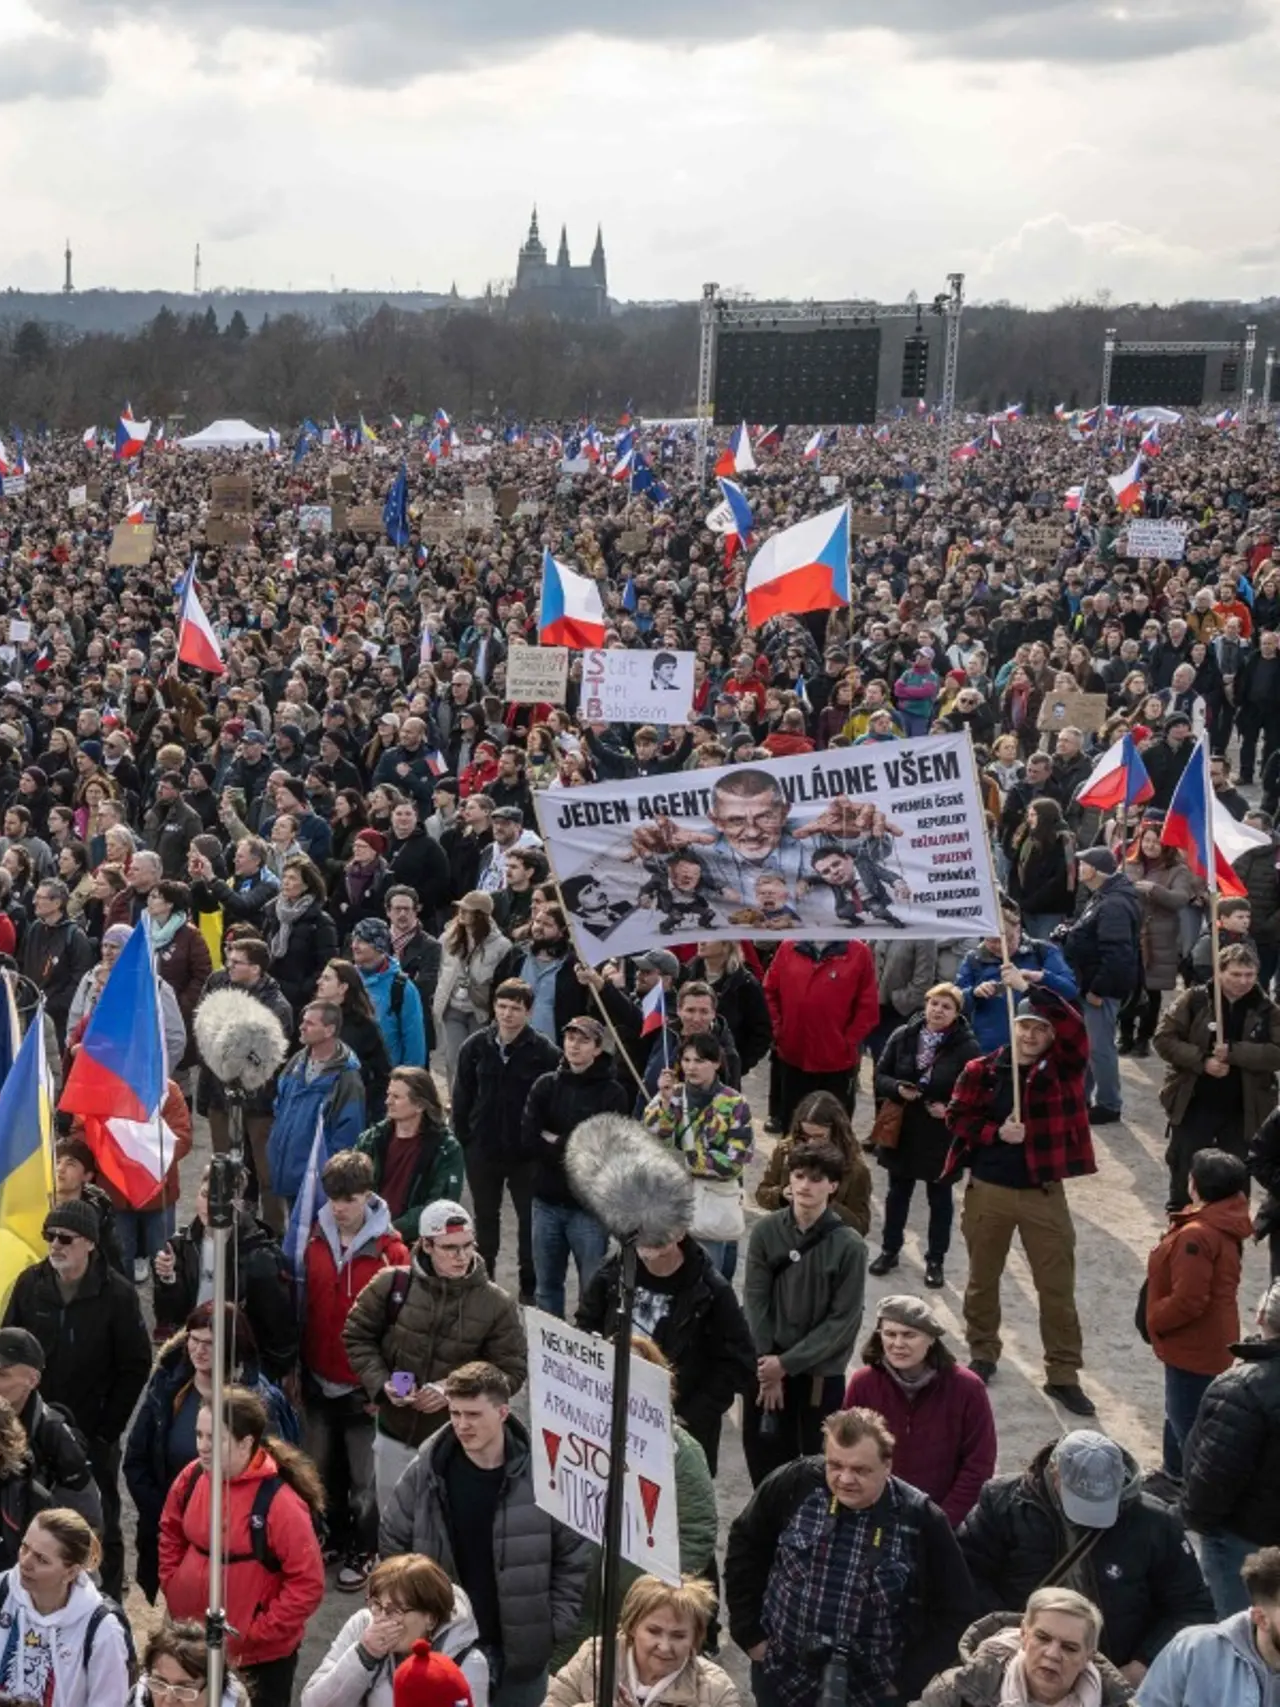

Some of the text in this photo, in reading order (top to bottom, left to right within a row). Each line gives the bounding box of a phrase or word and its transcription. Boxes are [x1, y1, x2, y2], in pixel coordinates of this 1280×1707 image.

[557, 751, 960, 829] JEDEN AGENT VLÁDNE VŠEM
[891, 799, 933, 814] PREMIÉR
[917, 812, 967, 829] REPUBLIKY
[913, 887, 980, 904] POSLANECKOU
[540, 1327, 606, 1371] NECHCEME
[563, 1431, 629, 1480] STO
